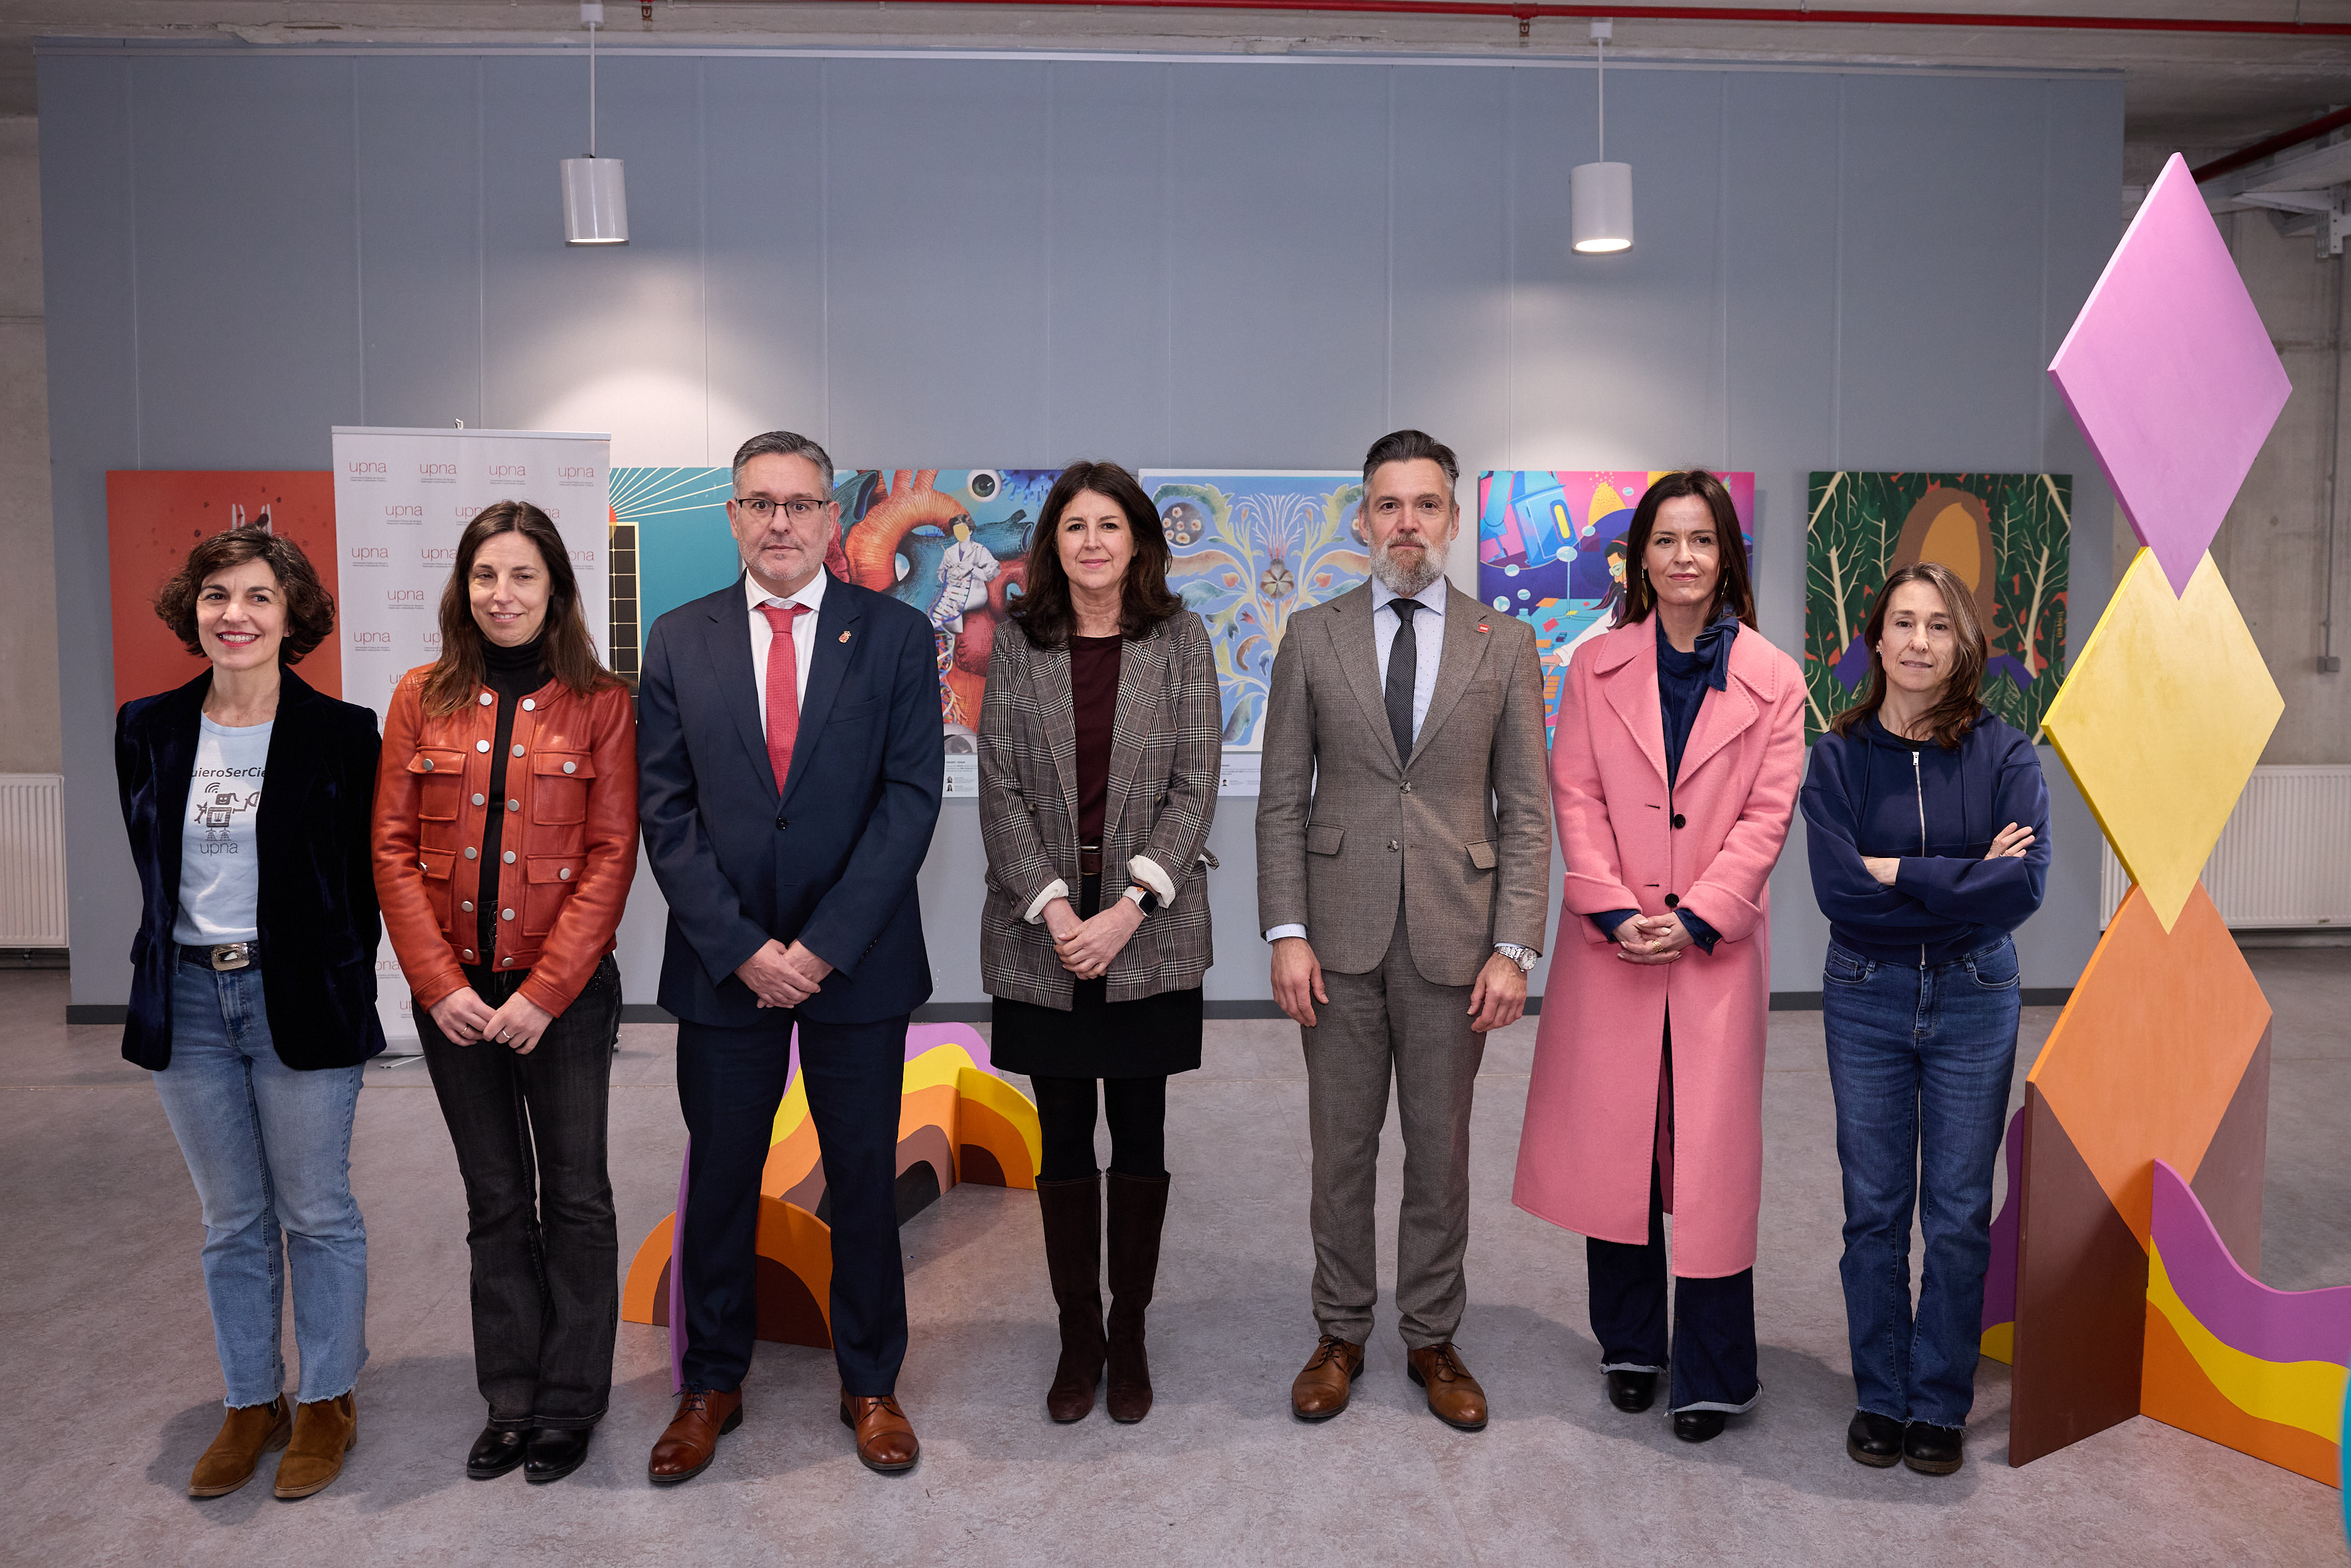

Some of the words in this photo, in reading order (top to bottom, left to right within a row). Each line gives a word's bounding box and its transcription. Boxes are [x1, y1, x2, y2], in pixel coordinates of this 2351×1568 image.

[349, 462, 387, 475] upna
[420, 464, 457, 476] upna
[489, 465, 526, 478] upna
[558, 466, 595, 480] upna
[385, 505, 423, 518] upna
[455, 506, 483, 520] upn
[543, 508, 560, 518] na
[352, 547, 389, 561] upna
[421, 548, 458, 561] upna
[567, 551, 595, 561] pna
[388, 590, 425, 603] upna
[354, 632, 391, 645] upna
[423, 632, 441, 645] up
[191, 766, 265, 778] uieroSerCie
[200, 843, 238, 857] upna
